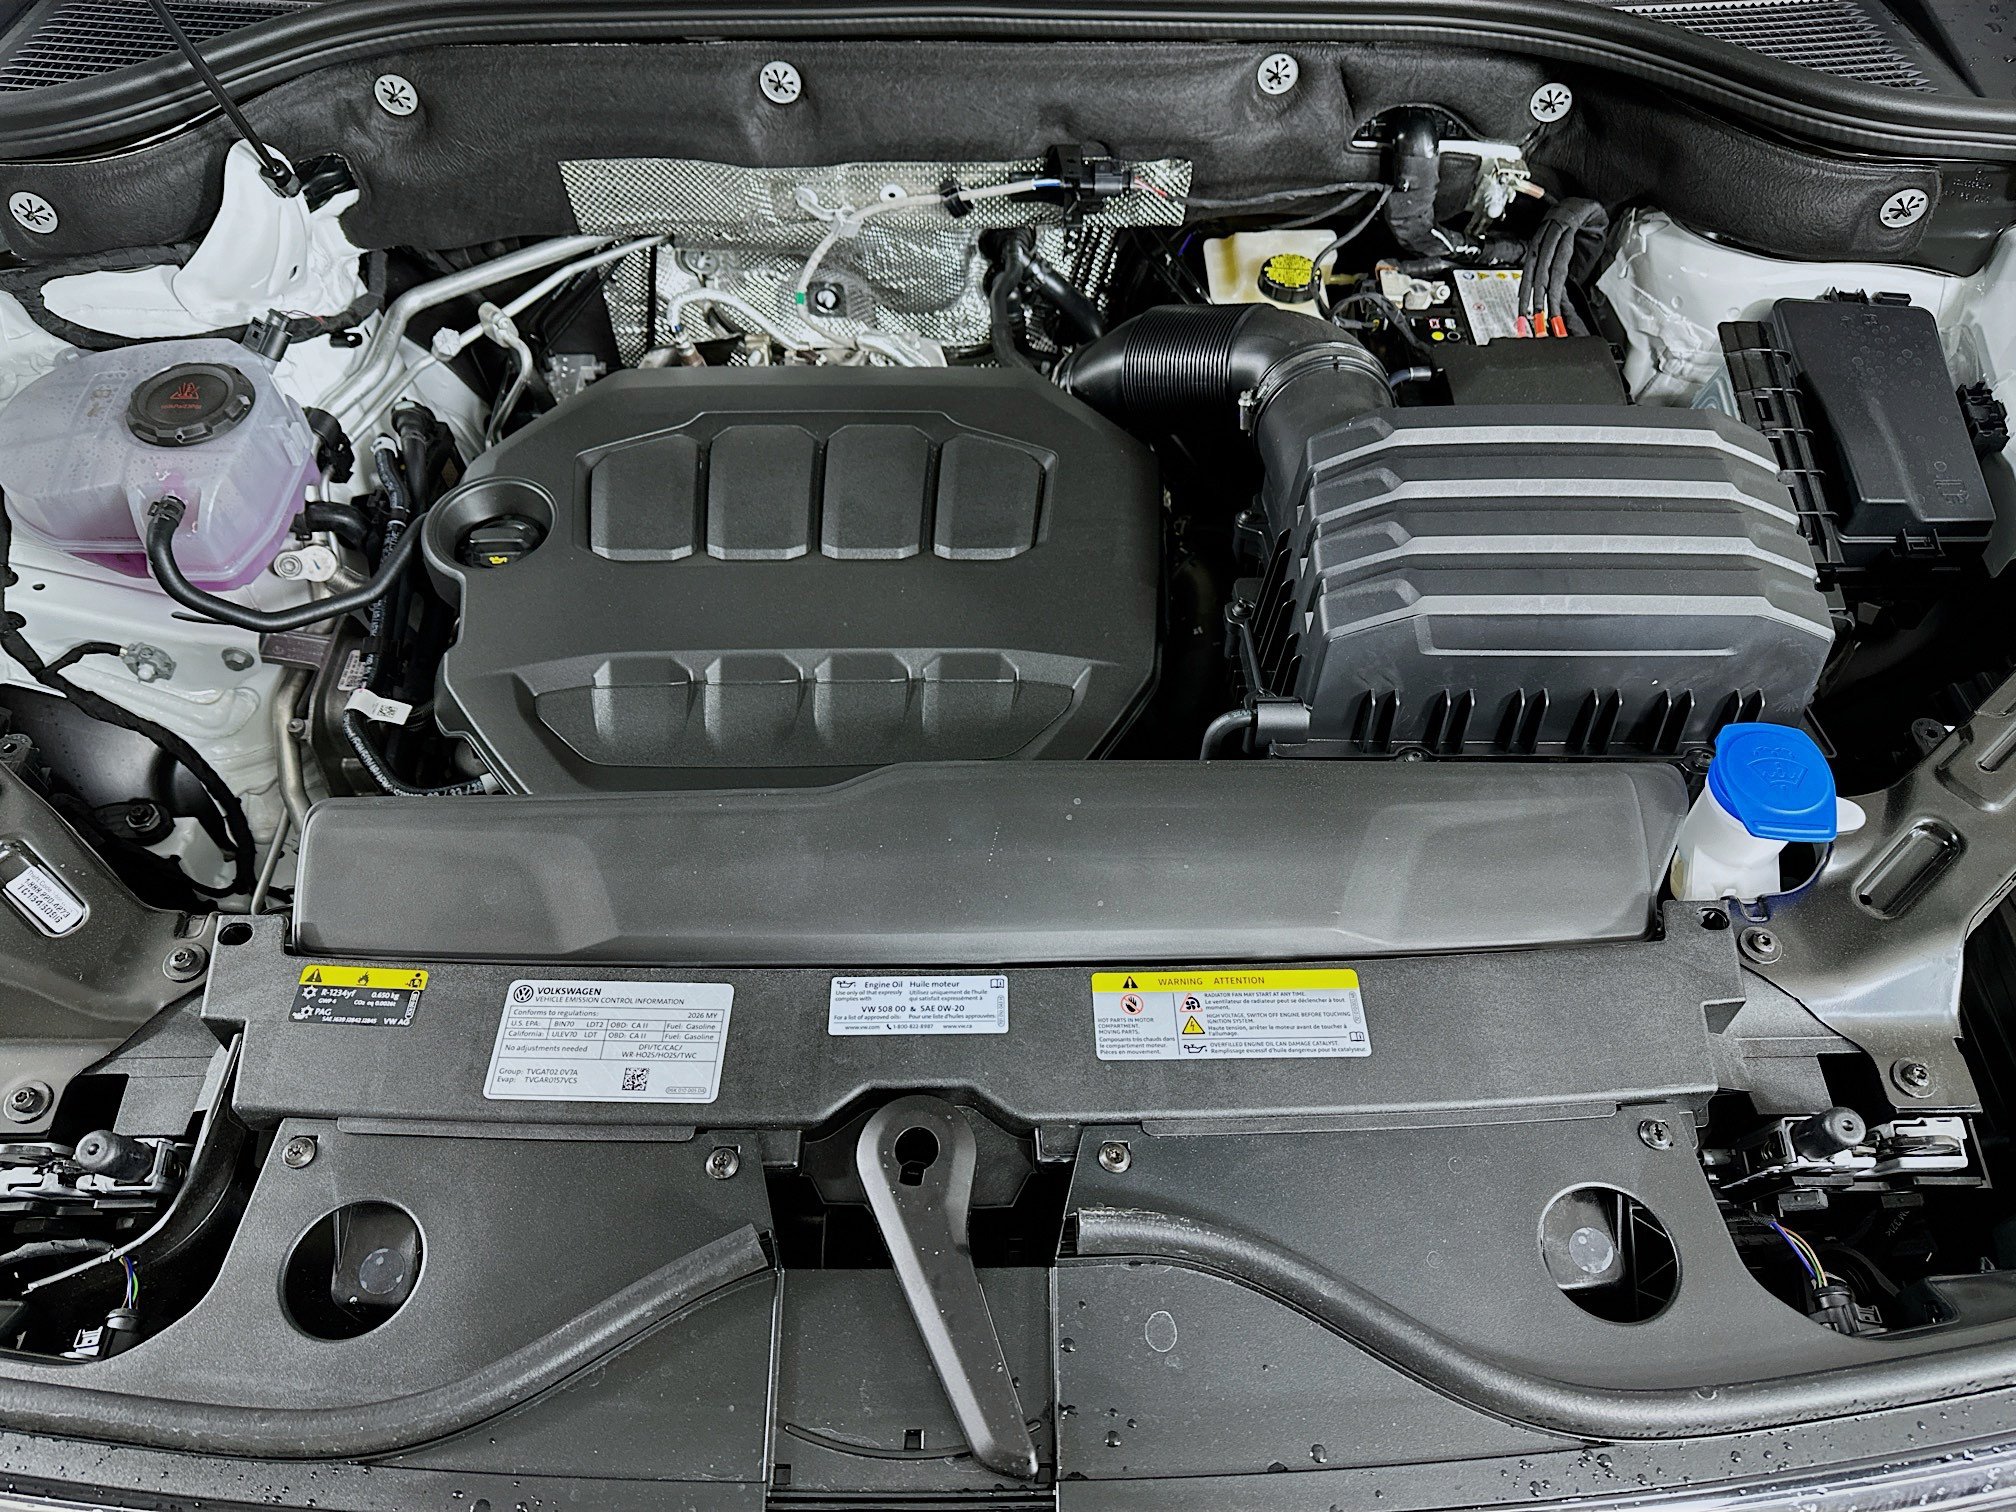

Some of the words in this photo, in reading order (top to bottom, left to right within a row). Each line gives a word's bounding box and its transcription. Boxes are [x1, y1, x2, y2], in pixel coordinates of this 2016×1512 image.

[1158, 978, 1203, 986] WARNING
[1214, 977, 1265, 985] ATTENTION
[865, 982, 890, 990] Engine
[321, 989, 357, 999] R-1234yf
[537, 987, 602, 996] VOLKSWAGEN
[391, 992, 400, 1000] kg
[314, 1008, 332, 1016] PAG
[516, 1045, 560, 1053] adjustments
